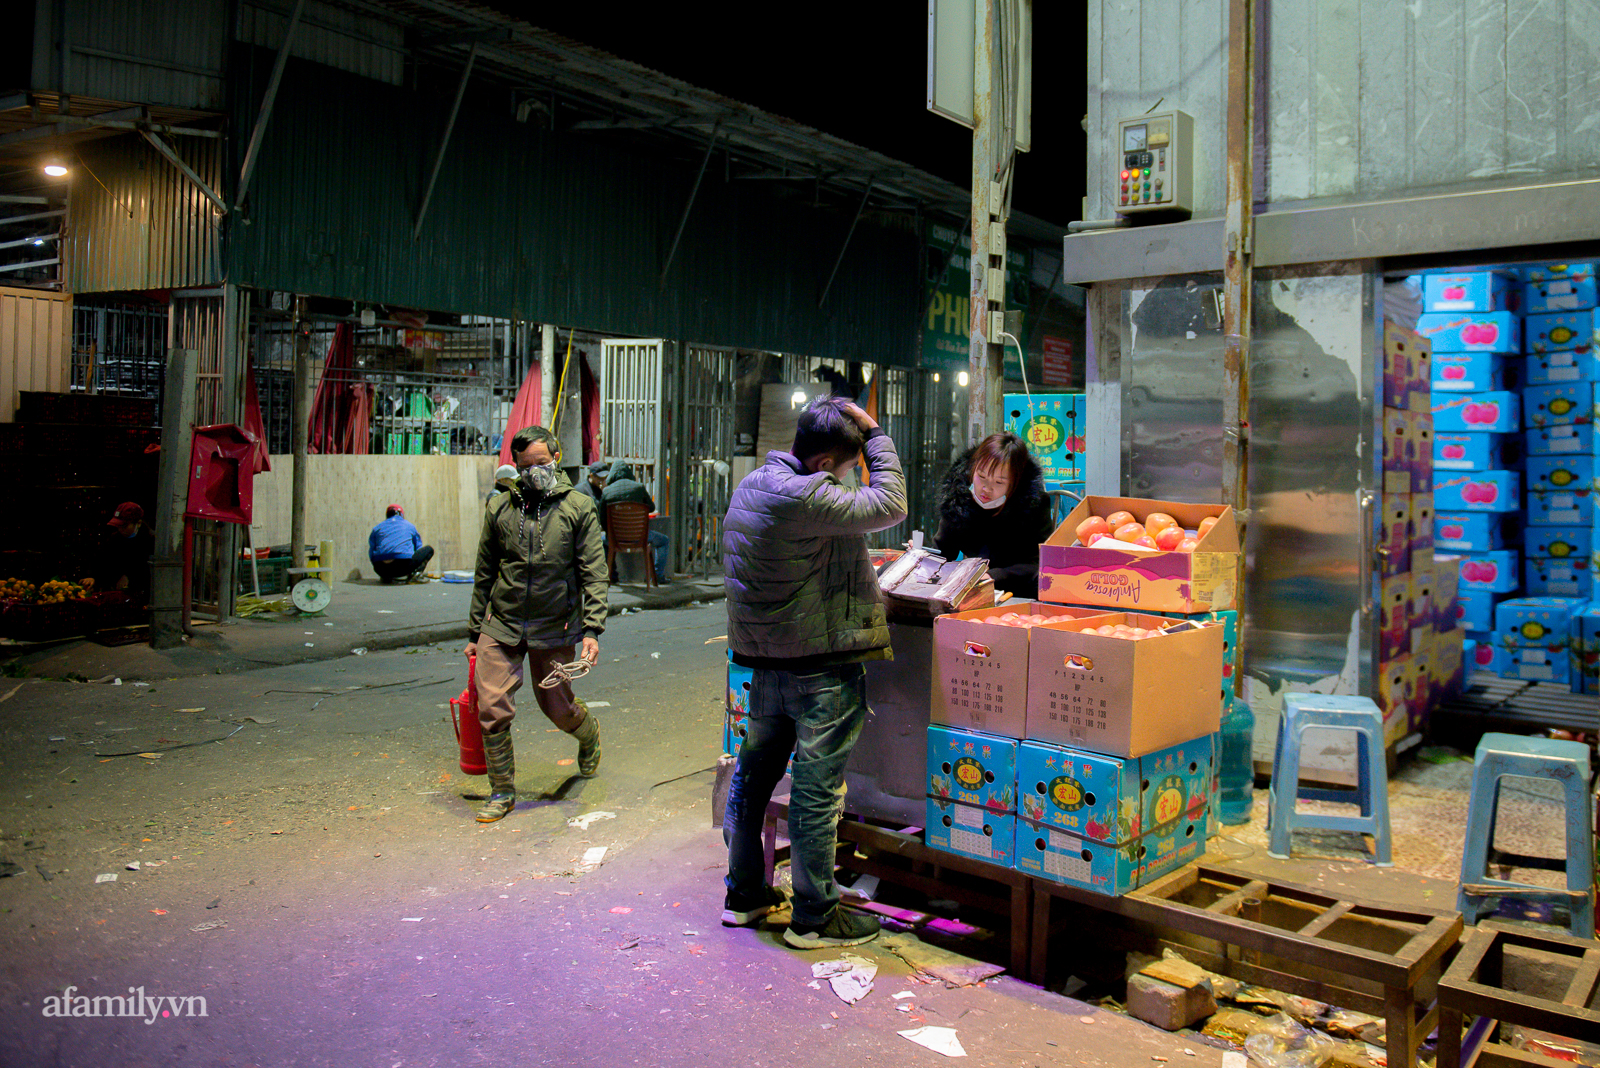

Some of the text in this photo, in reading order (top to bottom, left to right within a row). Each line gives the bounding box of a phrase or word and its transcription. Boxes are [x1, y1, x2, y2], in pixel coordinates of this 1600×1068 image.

[1039, 456, 1052, 466] 68
[1058, 468, 1081, 477] FRUT
[1091, 573, 1128, 586] GOLD
[1084, 579, 1141, 603] Ambrosia
[1087, 697, 1093, 705] 72
[958, 791, 980, 804] 268
[1054, 811, 1079, 827] 268
